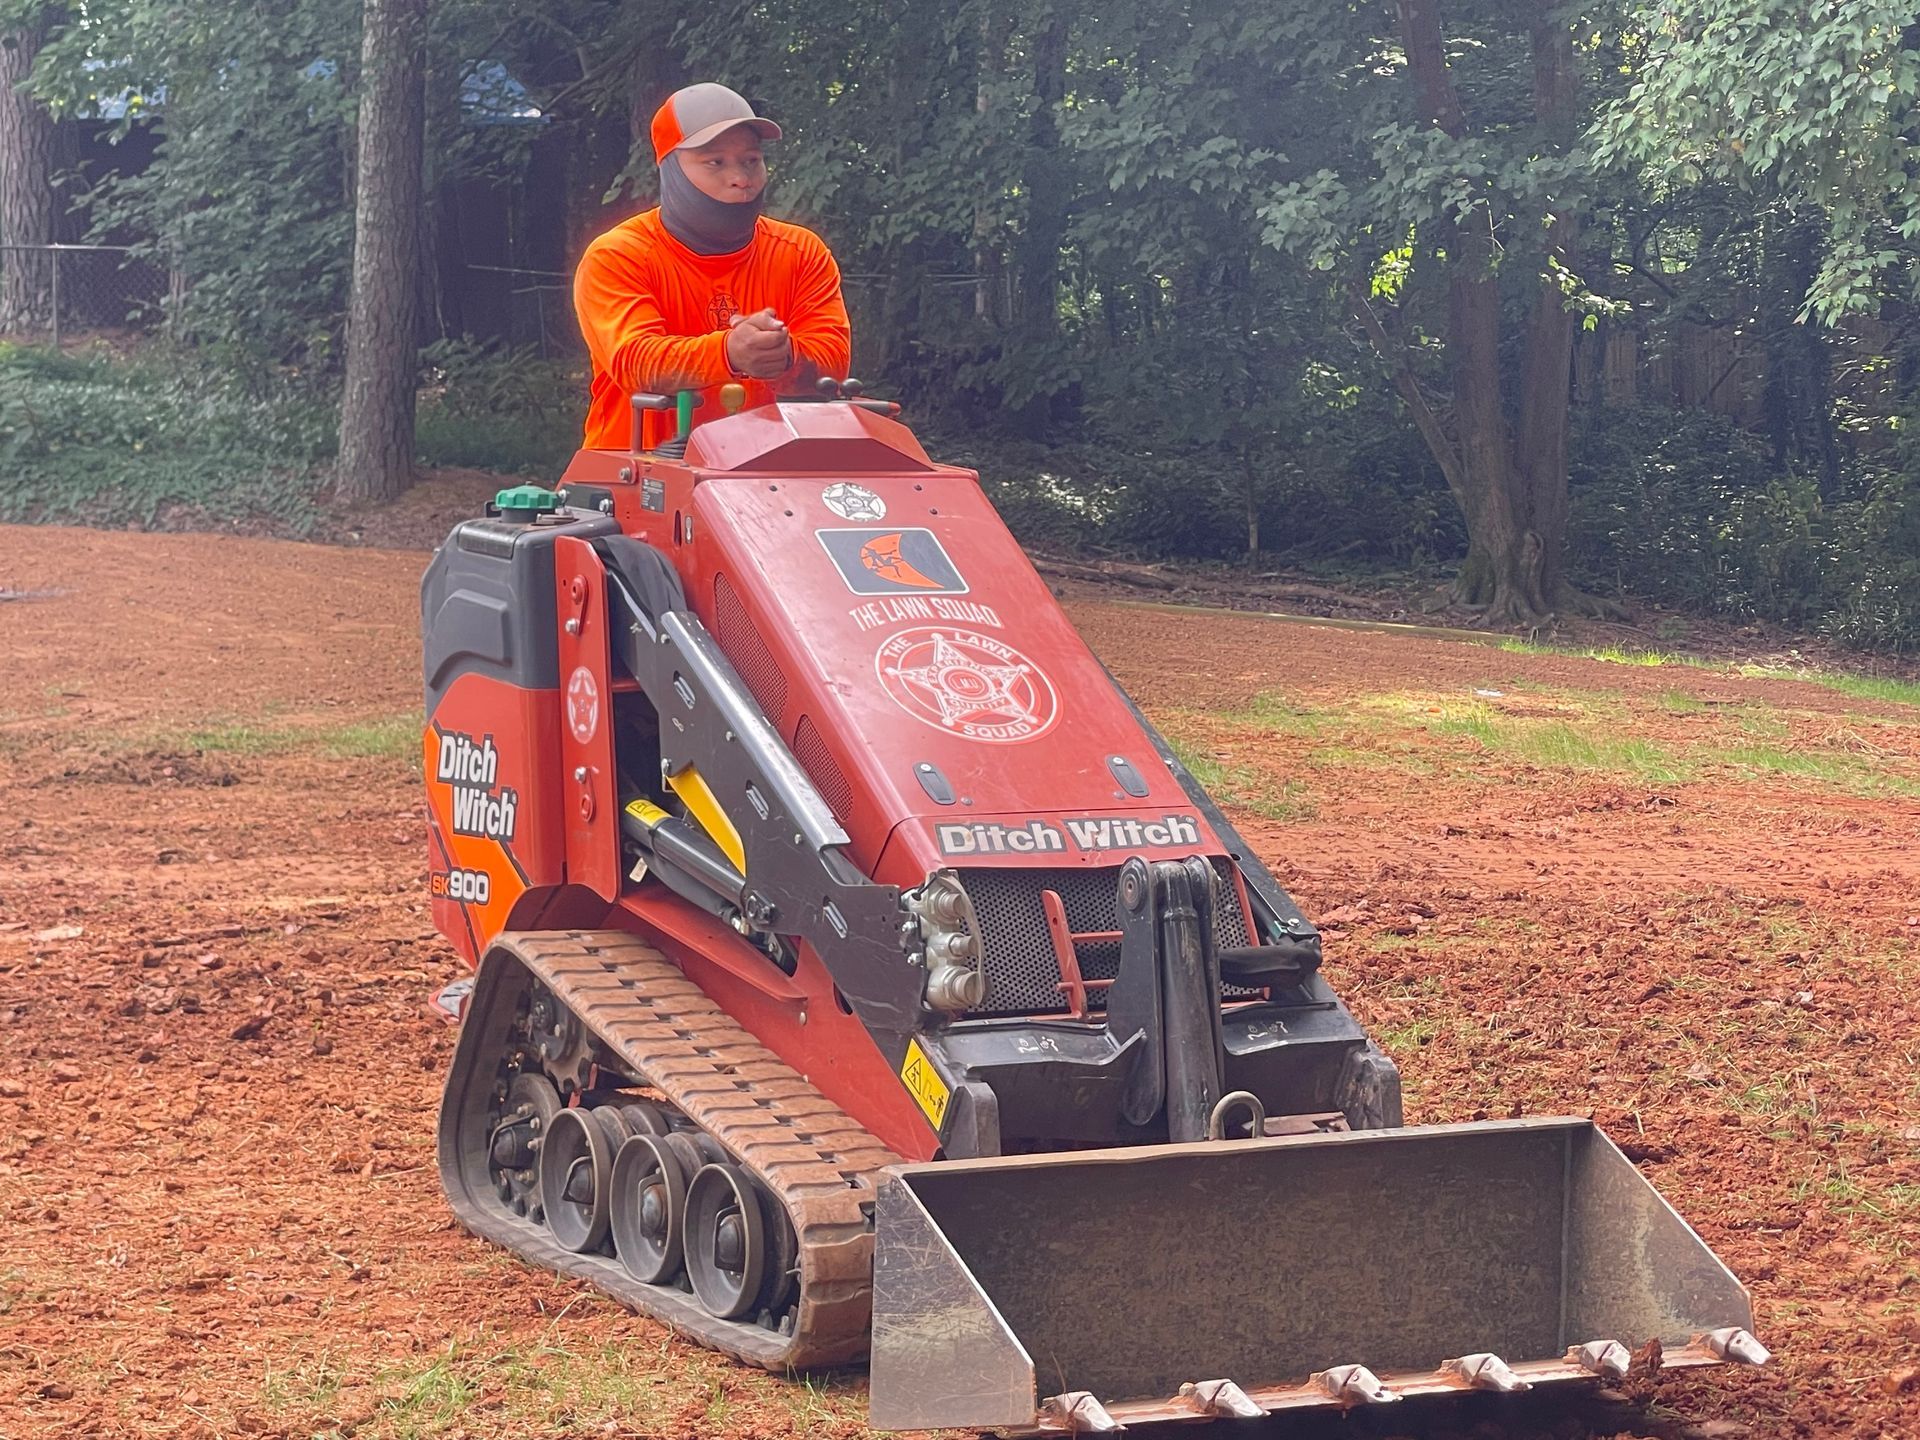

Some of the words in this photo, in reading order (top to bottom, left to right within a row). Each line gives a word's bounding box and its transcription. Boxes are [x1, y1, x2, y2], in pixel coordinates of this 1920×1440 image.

[848, 602, 885, 632] THE
[878, 596, 935, 622] LAWN
[929, 596, 1003, 628] SQUAD
[882, 636, 913, 658] THE
[954, 631, 1013, 659] LAWN
[962, 721, 1032, 740] SQUAD
[438, 734, 497, 784] Ditch
[453, 786, 516, 837] Witch
[939, 821, 1063, 853] Ditch
[1067, 815, 1199, 848] Witch
